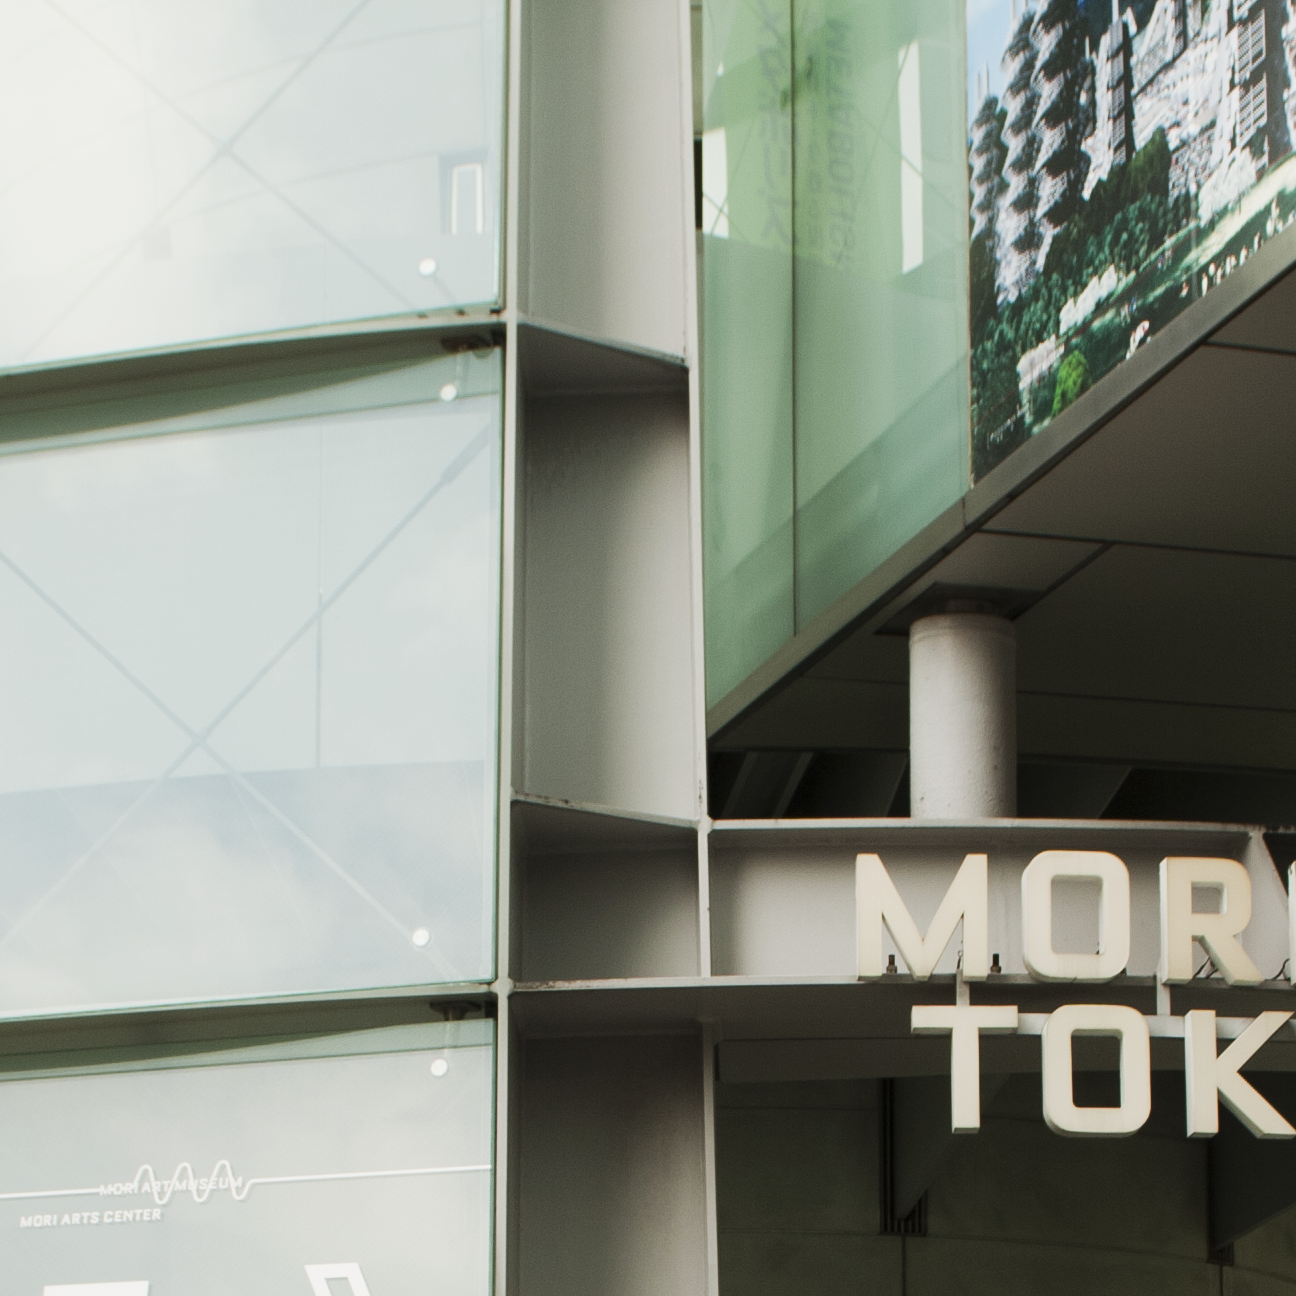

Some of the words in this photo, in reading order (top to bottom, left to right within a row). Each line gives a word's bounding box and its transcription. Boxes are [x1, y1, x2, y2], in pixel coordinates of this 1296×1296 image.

[100, 1182, 139, 1196] MORI
[141, 1180, 170, 1194] ART
[173, 1176, 242, 1193] MUSEUM
[20, 1214, 58, 1228] MORI
[60, 1211, 100, 1226] ARTS
[103, 1208, 163, 1223] CENTER
